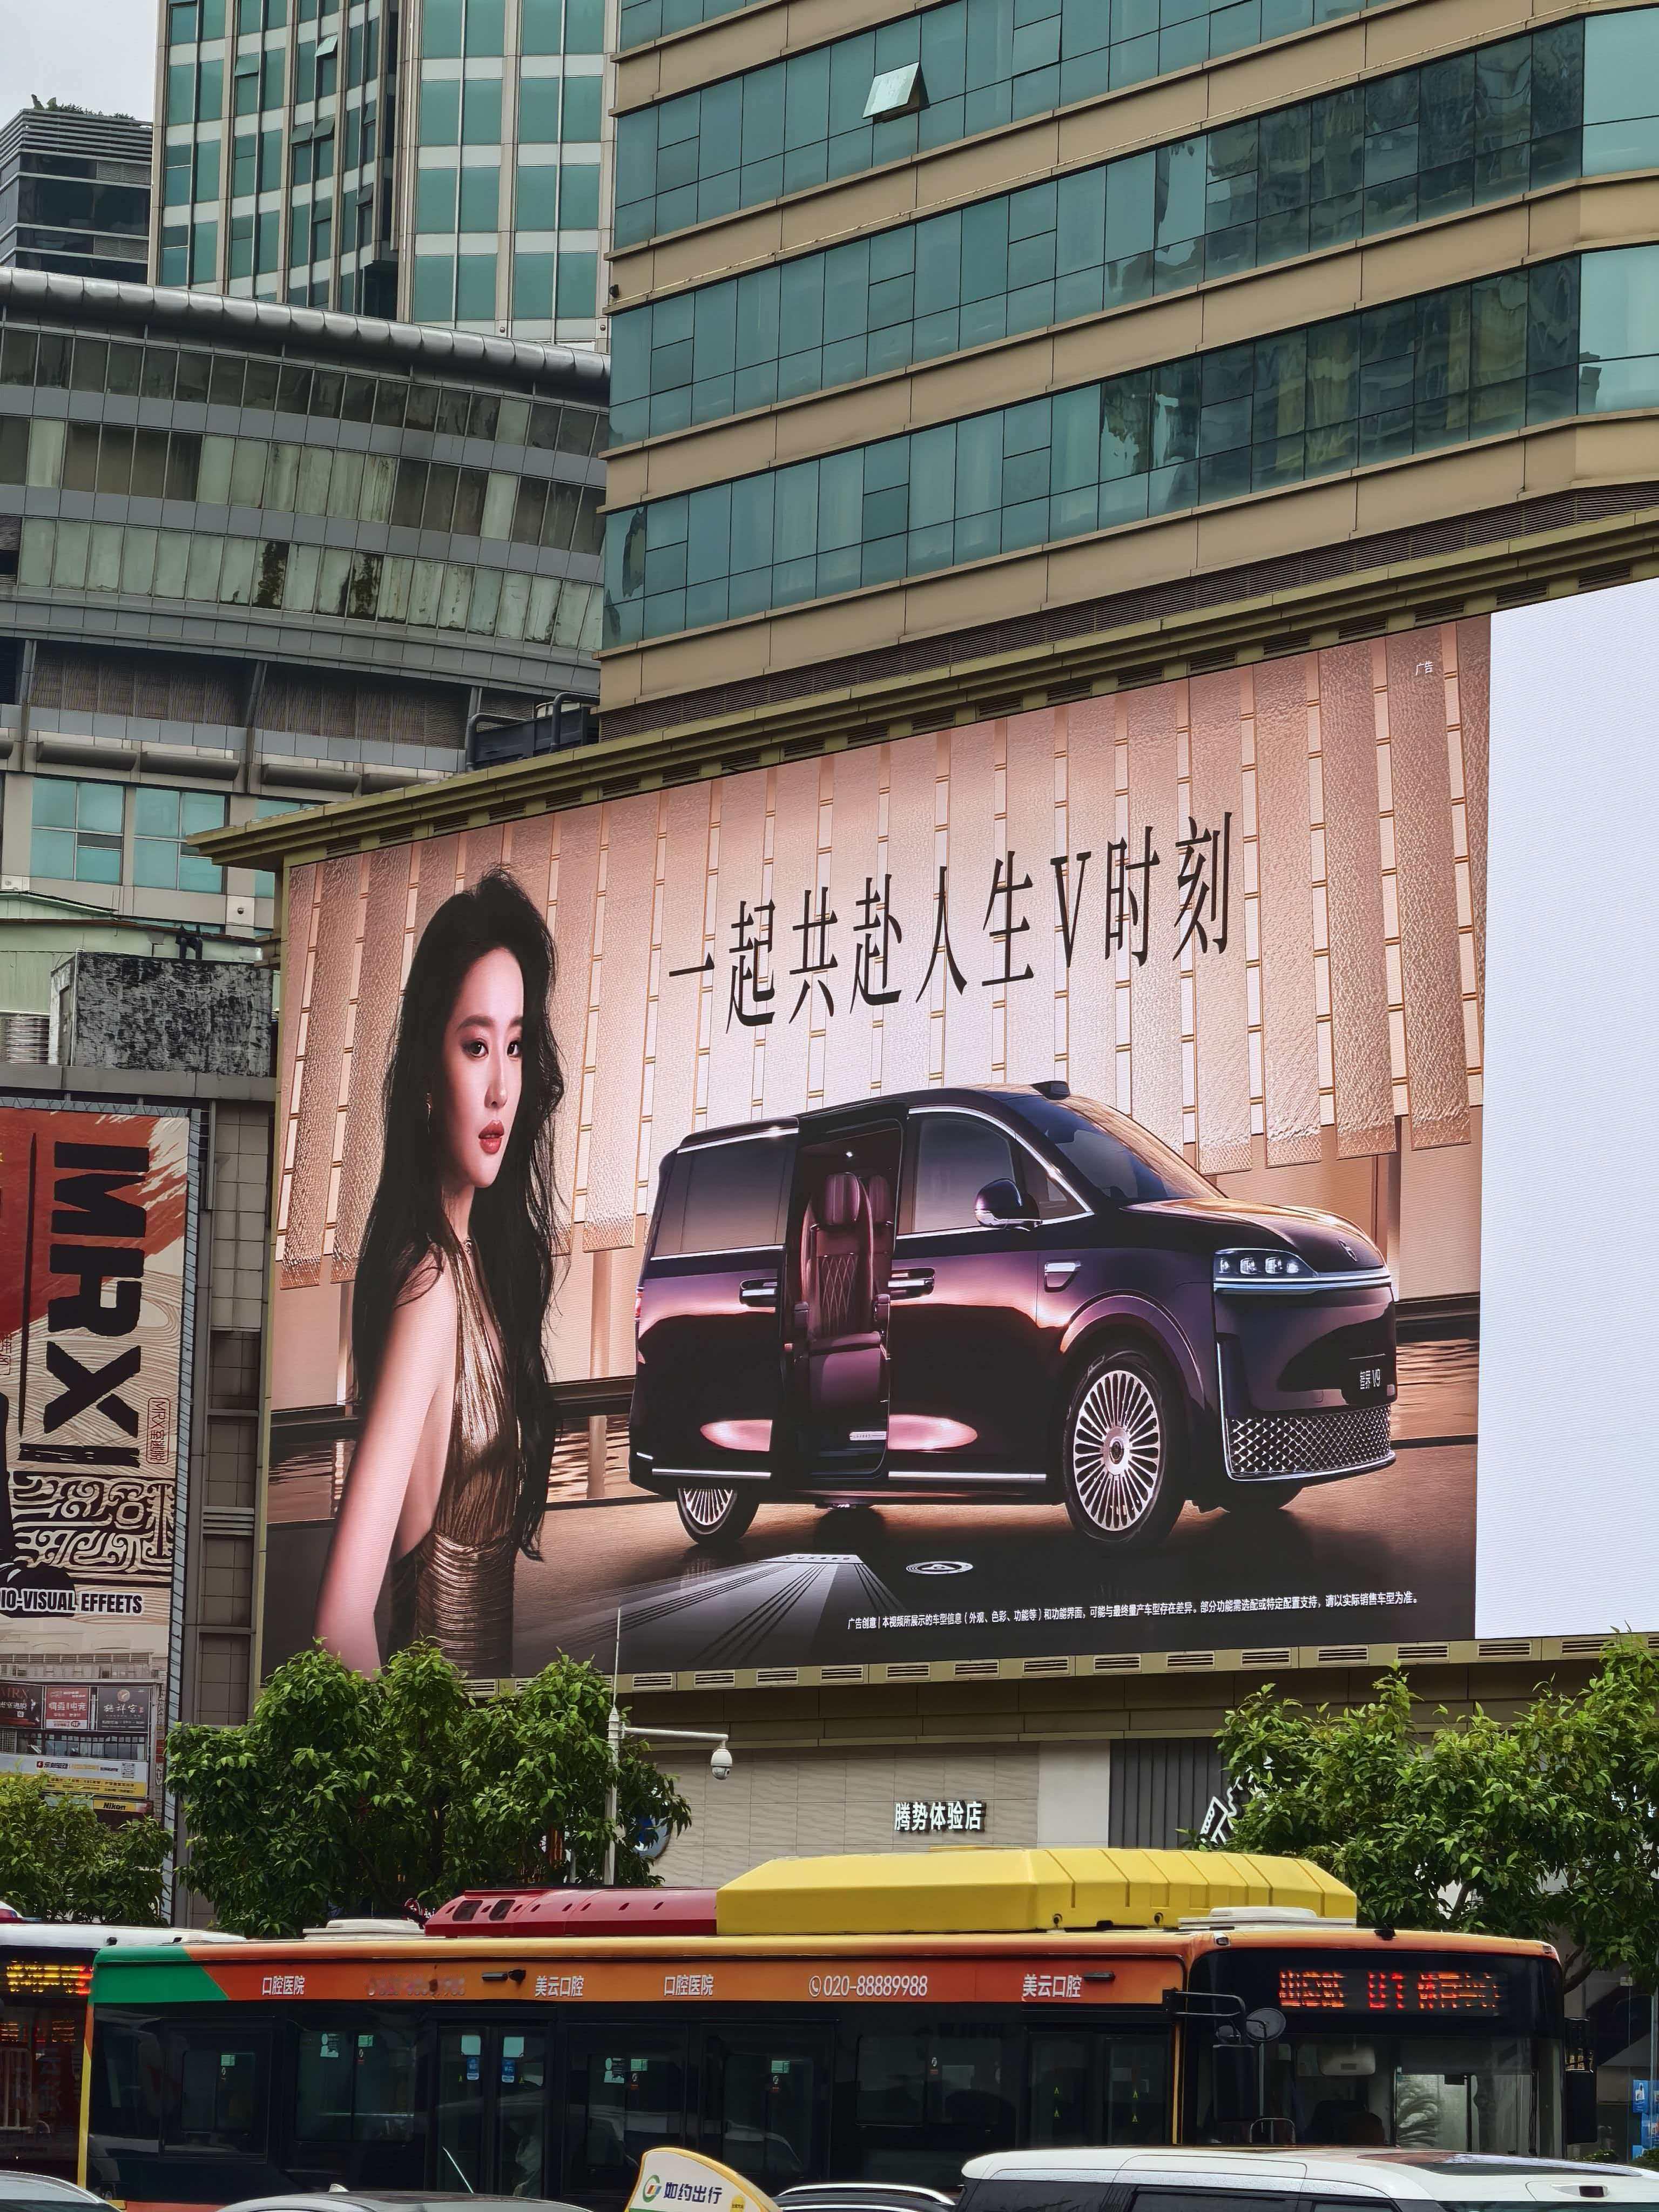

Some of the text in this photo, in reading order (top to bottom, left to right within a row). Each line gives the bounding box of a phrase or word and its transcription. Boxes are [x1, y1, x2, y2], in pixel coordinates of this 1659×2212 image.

[1415, 660, 1434, 676] 广告
[668, 812, 1233, 1034] 一起共赴人生V时刻
[103, 1802, 126, 1810] Nikon
[894, 1801, 982, 1831] 腾势体验店
[262, 1975, 306, 1996] 口腔医院
[535, 1975, 585, 1998] 美云口腔
[664, 1974, 714, 1997] 口腔医院
[823, 1975, 928, 1997] 020-88889988
[1022, 1974, 1083, 1998] 美云口腔
[664, 2181, 723, 2204] 如约出行
